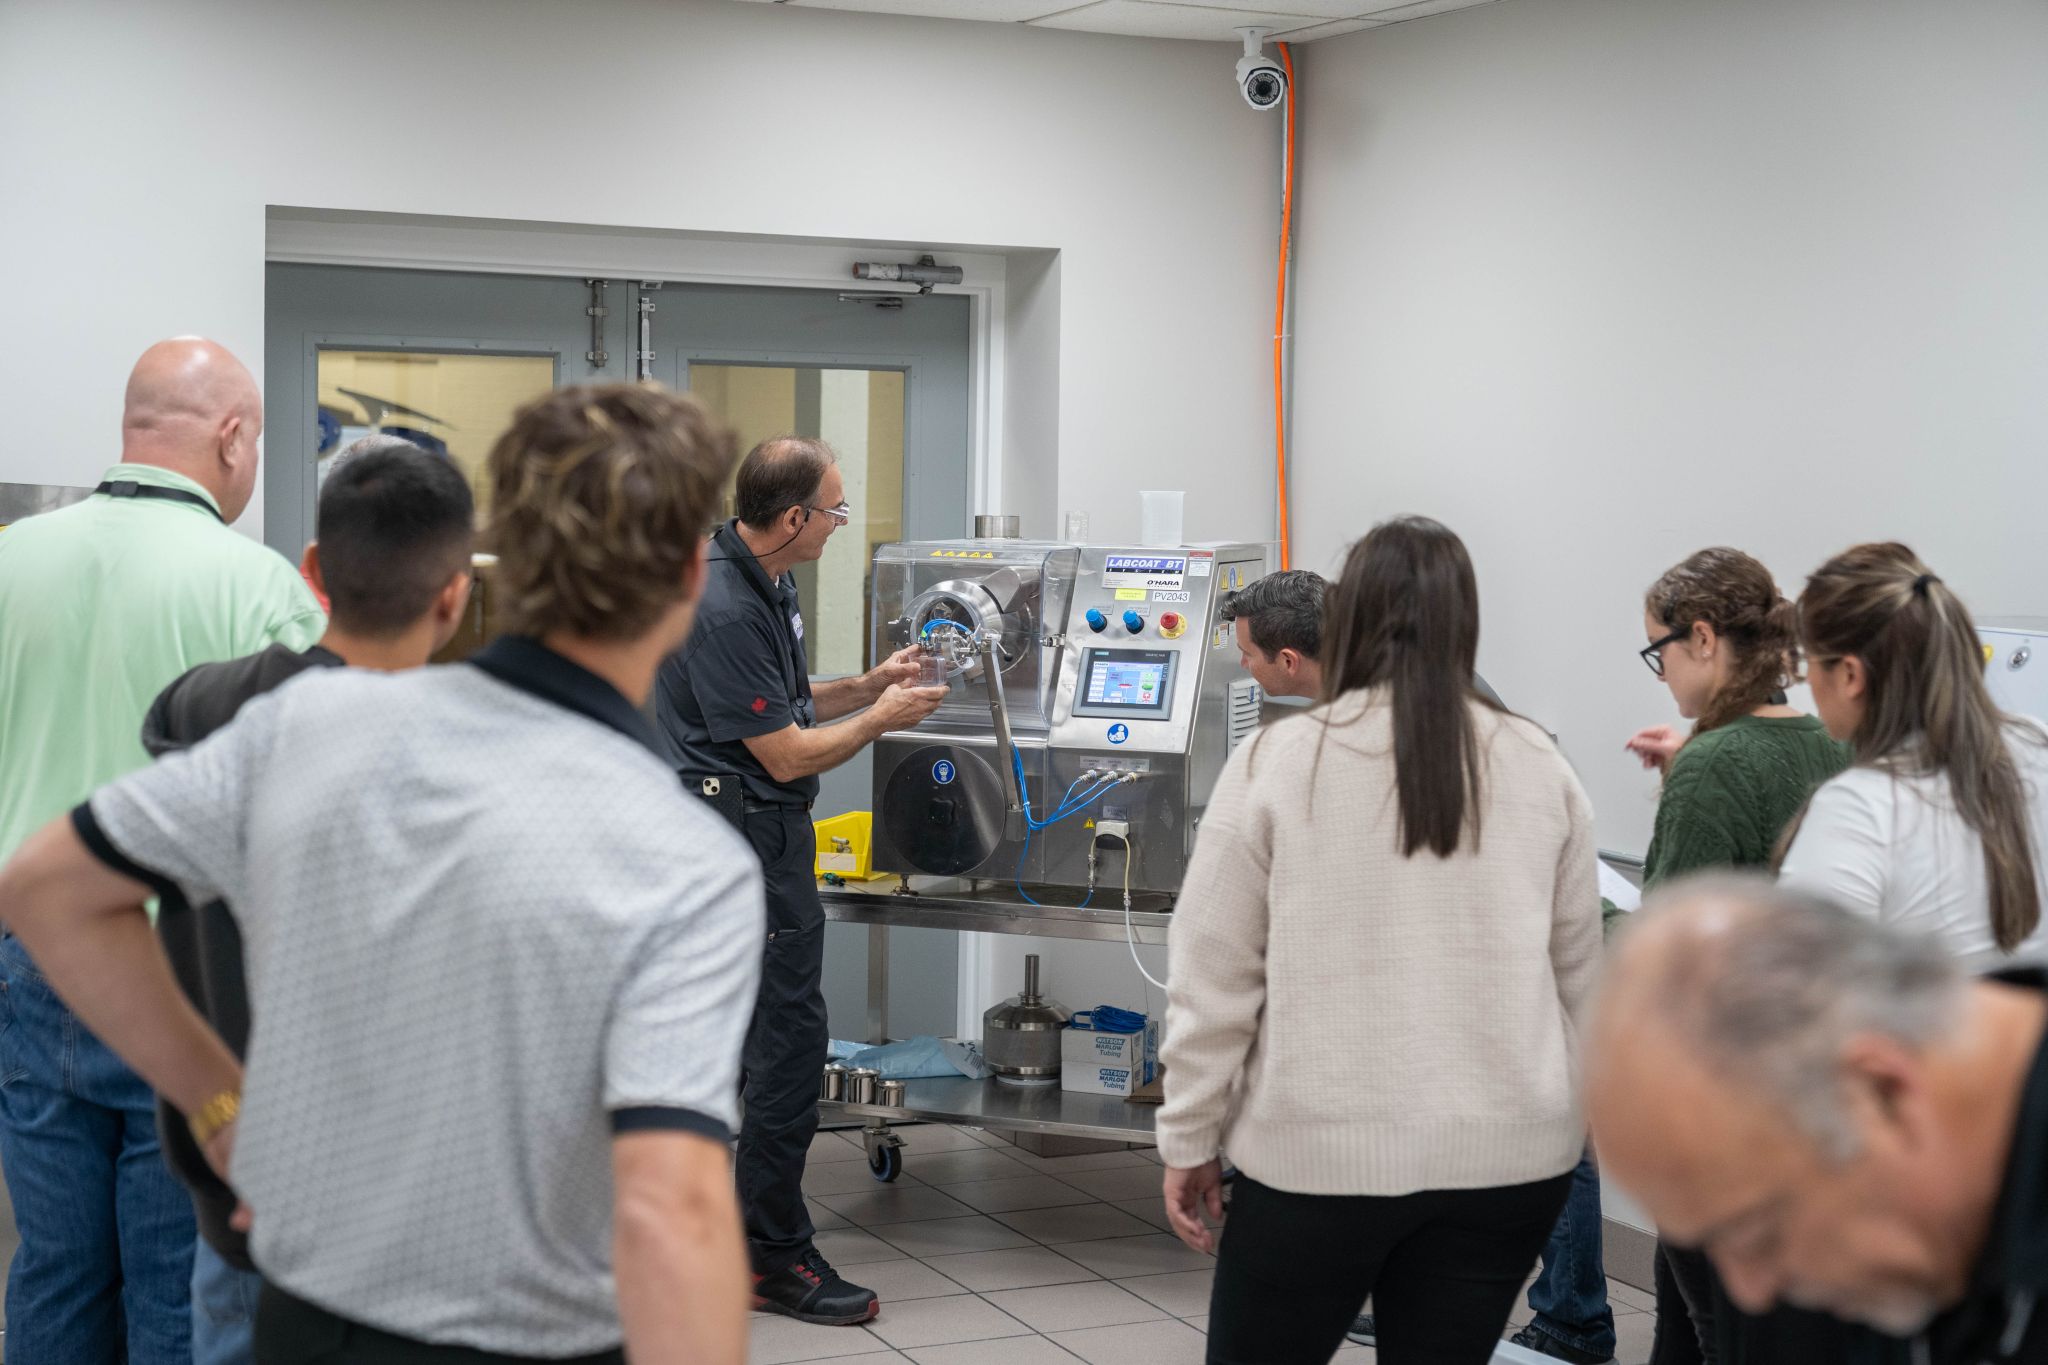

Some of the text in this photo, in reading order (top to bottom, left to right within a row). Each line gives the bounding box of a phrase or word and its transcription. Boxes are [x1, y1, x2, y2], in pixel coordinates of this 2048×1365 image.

[1108, 559, 1161, 568] LABCOAT
[1166, 560, 1182, 569] BT
[1154, 592, 1188, 601] PV2043
[1097, 1037, 1123, 1045] WATSON
[1100, 1049, 1122, 1058] Tubing
[1099, 1075, 1126, 1083] MARLOW
[1104, 1081, 1125, 1090] Tubing
